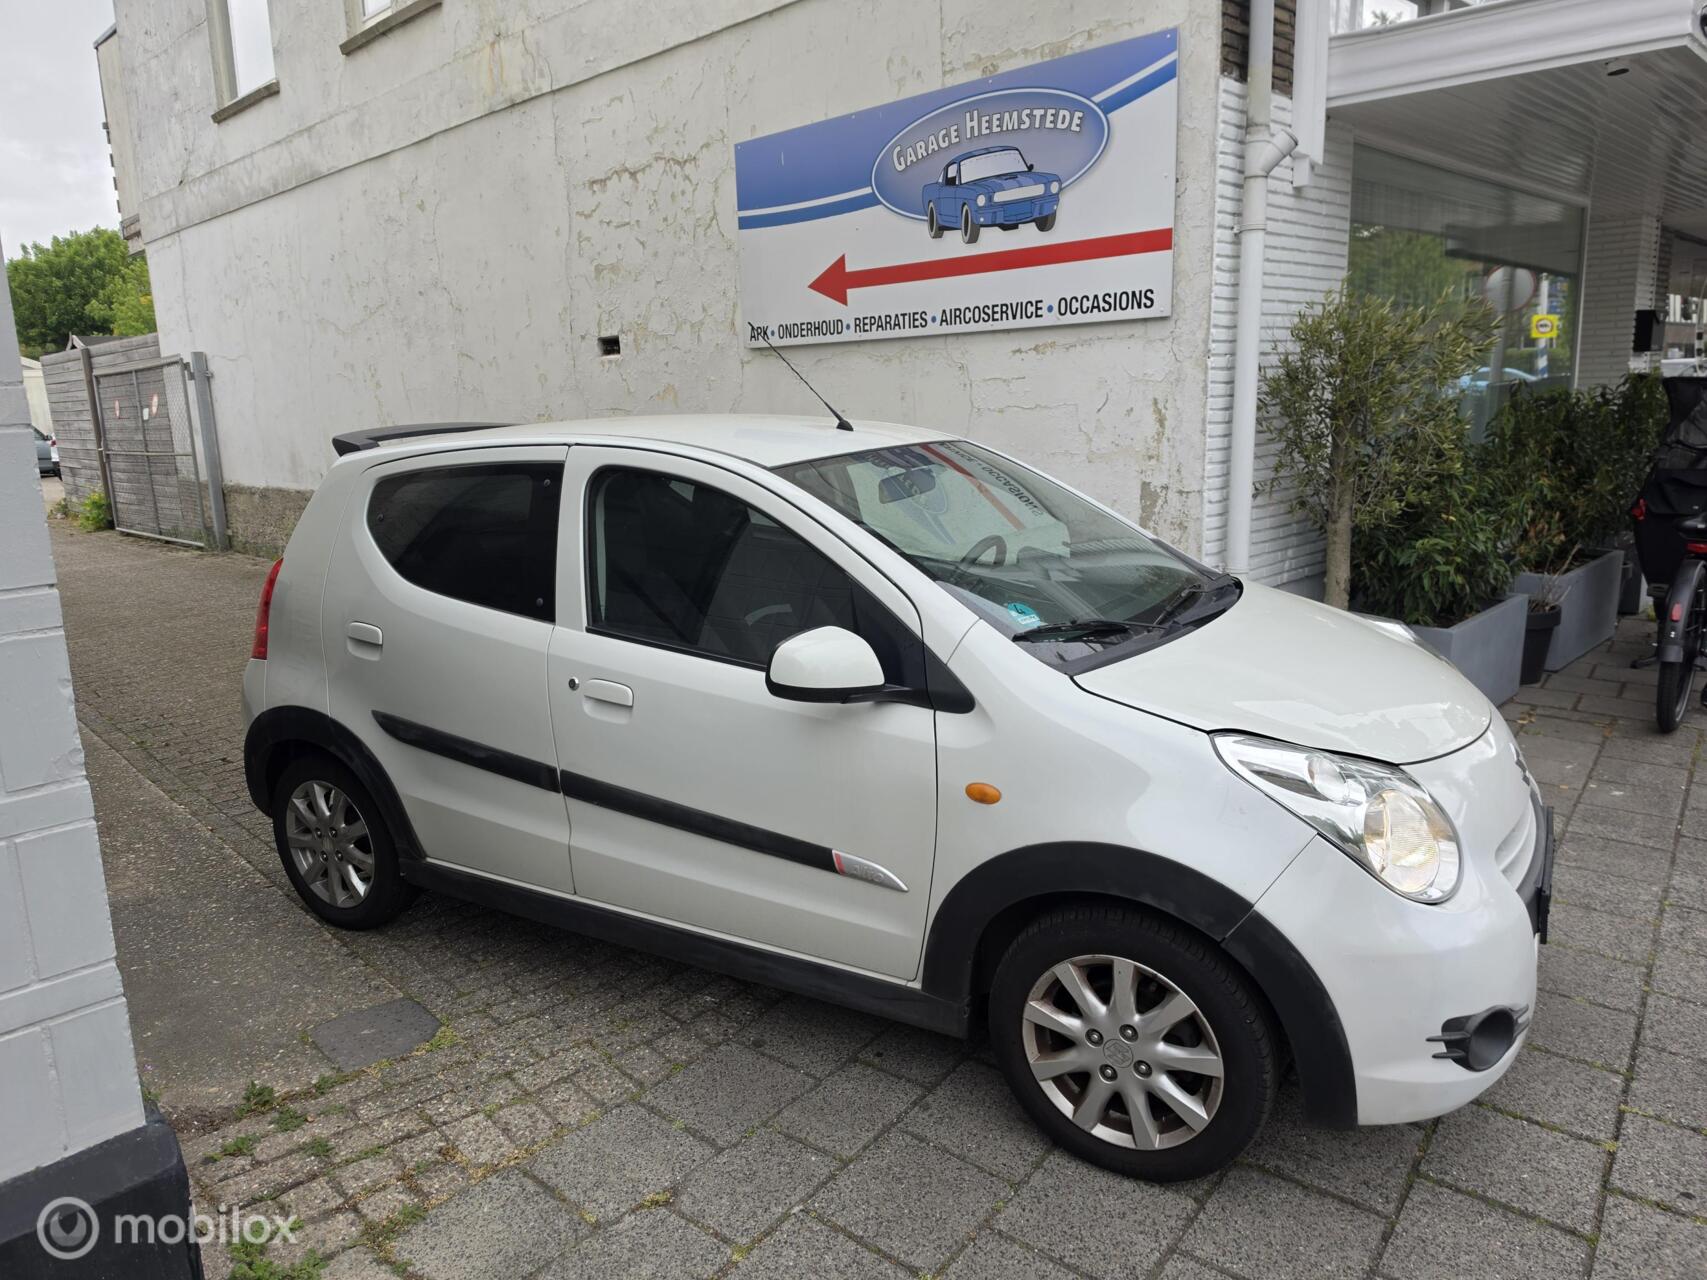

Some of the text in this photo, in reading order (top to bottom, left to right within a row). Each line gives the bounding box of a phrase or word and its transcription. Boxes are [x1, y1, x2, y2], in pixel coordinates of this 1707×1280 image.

[893, 108, 1084, 172] GARAGE HEEMSTEDE
[777, 319, 844, 339] ONDERHOUD
[854, 311, 928, 333] REPARATIES
[939, 300, 1044, 327] AIRCOSERVICE
[1057, 288, 1155, 316] OCCASIONS
